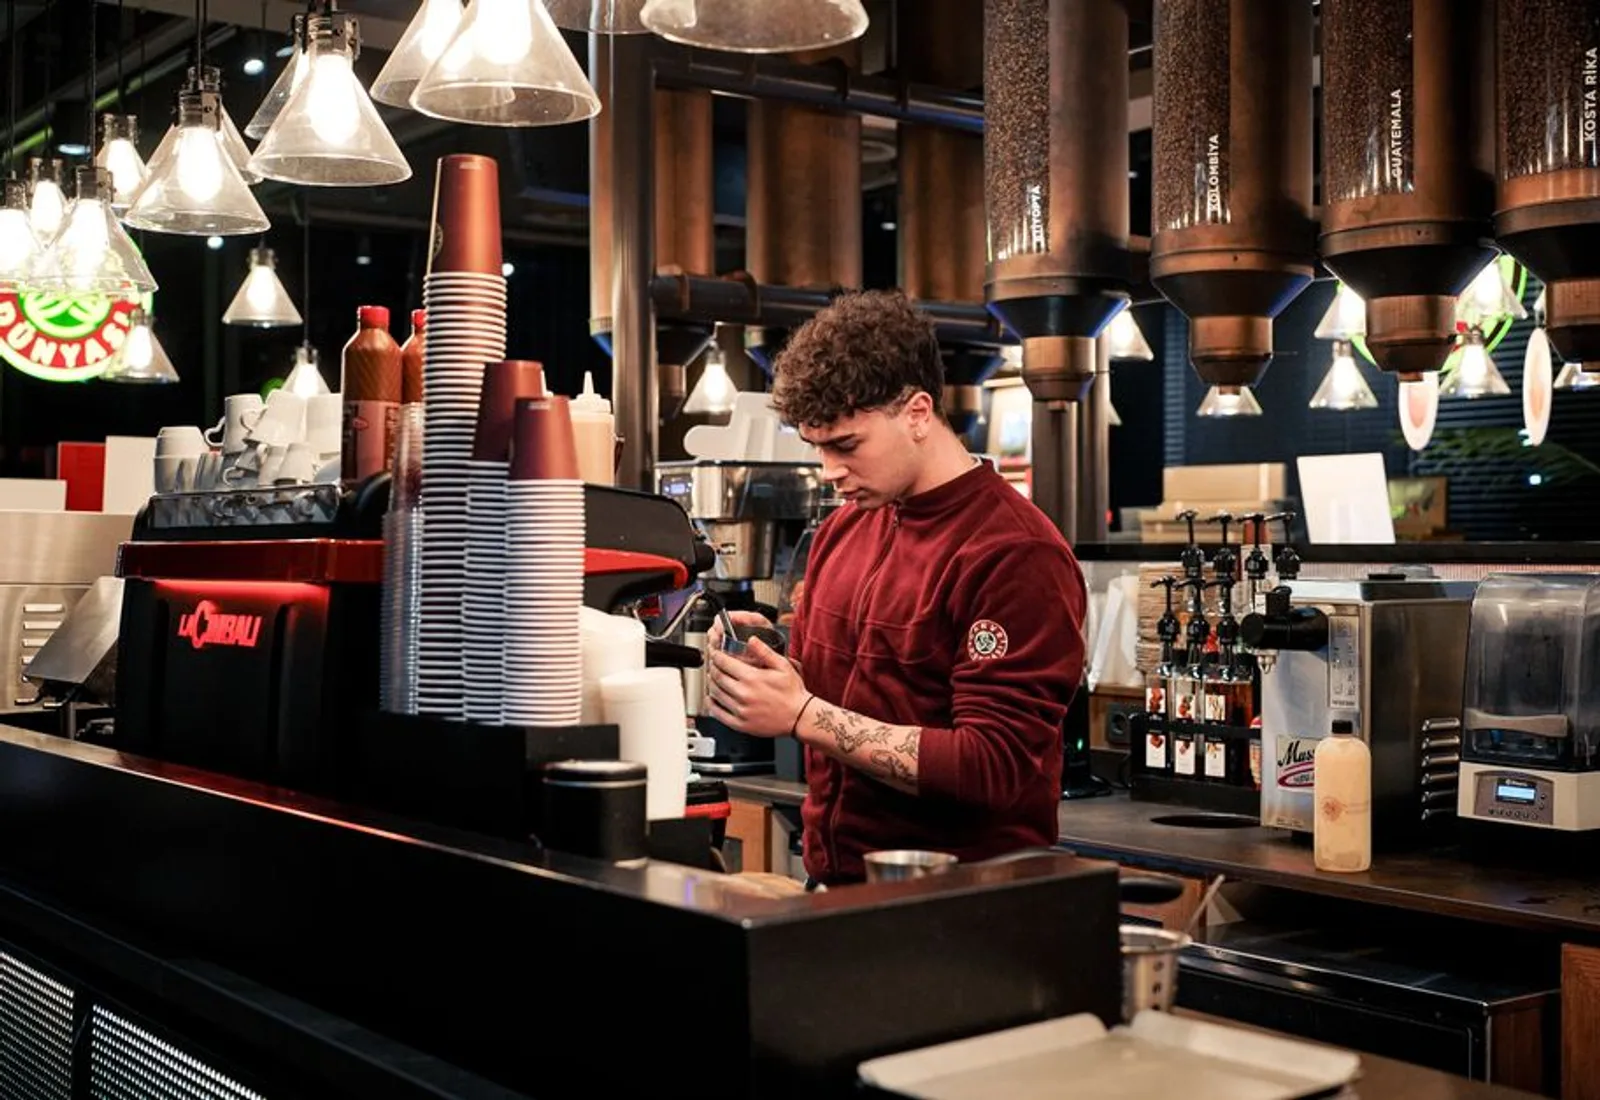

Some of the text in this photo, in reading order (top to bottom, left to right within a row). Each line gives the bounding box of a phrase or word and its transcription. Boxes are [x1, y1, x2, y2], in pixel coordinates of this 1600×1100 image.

[1390, 88, 1403, 178] GUATEMALA
[1582, 47, 1598, 142] KOSTA RİKA
[1207, 133, 1219, 213] KOLOMBİYA
